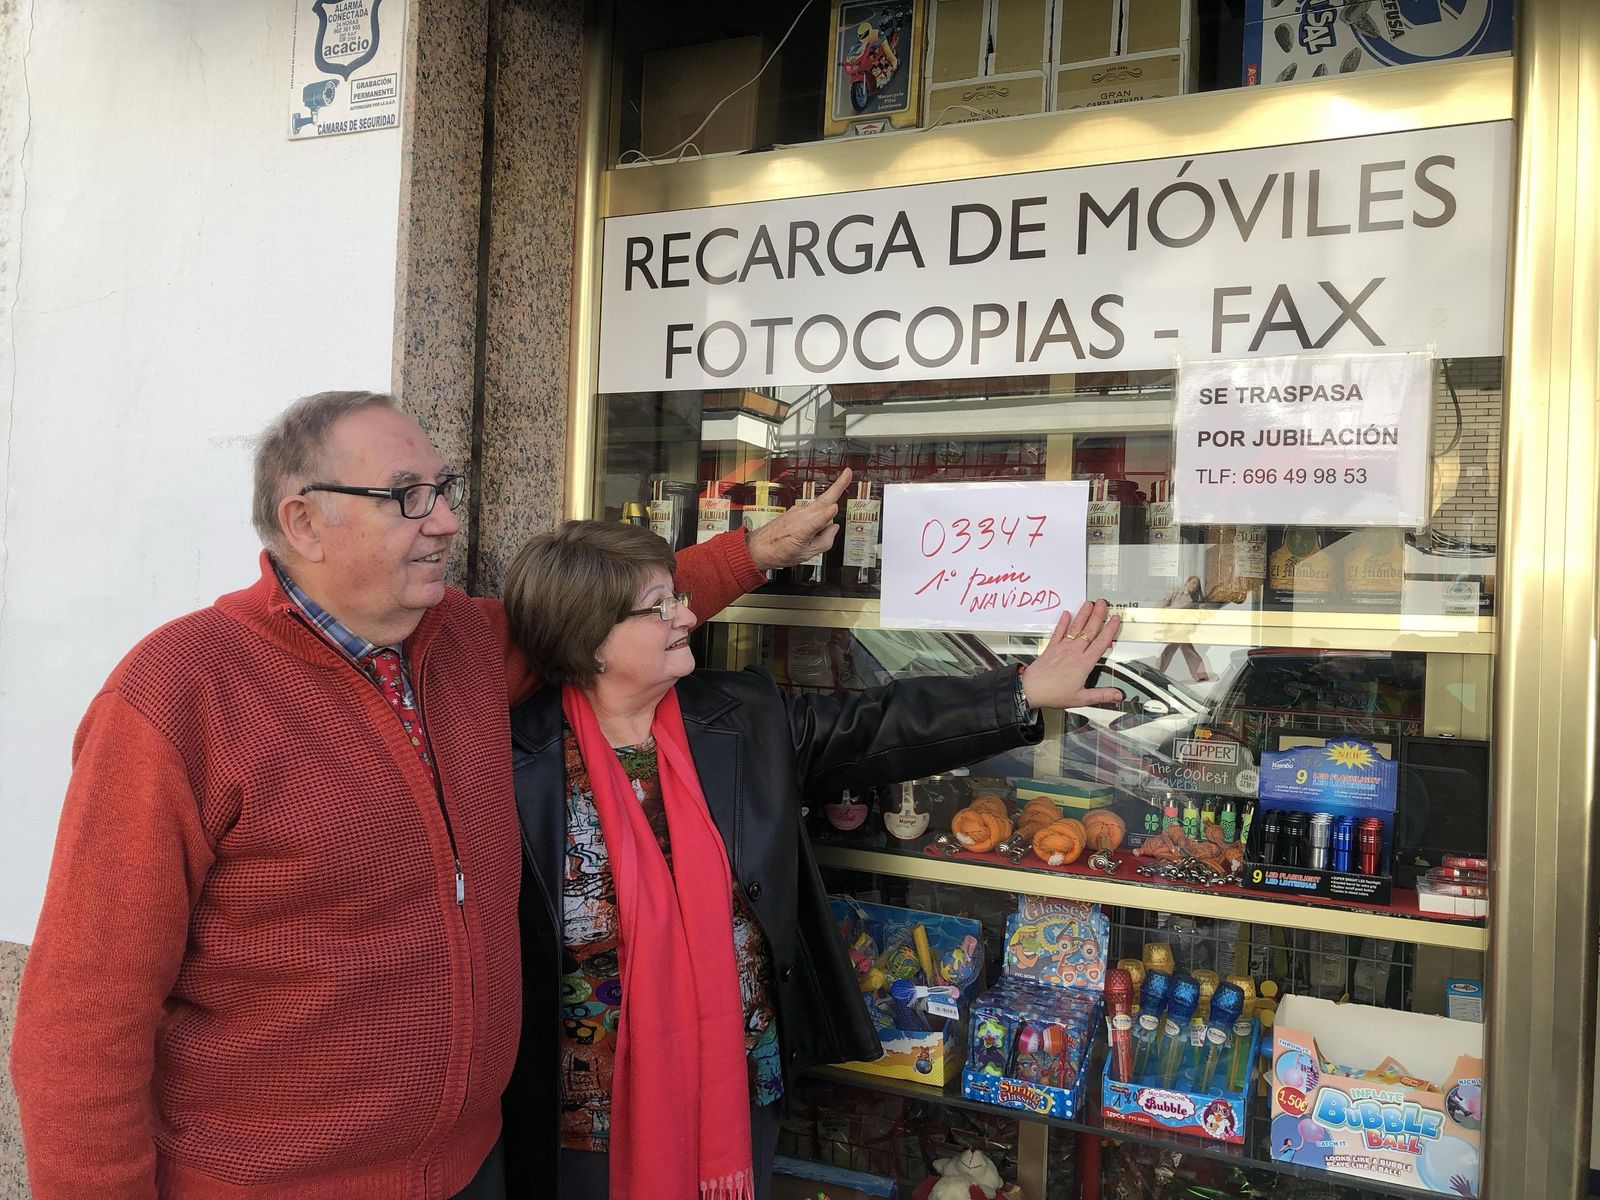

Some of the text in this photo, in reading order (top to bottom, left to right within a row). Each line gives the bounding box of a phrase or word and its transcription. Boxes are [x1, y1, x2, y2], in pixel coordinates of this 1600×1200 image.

[335, 1, 363, 12] ALARMA
[328, 8, 368, 23] CONECTADA
[1380, 0, 1406, 40] FUSA
[1303, 0, 1333, 52] SAL
[324, 36, 369, 56] acacio
[356, 78, 392, 89] GRABACIÓN
[353, 88, 394, 100] PERMANENTE
[1100, 90, 1131, 100] GRAN
[318, 114, 395, 135] CÁMARAS DE SEGURIDAD
[625, 160, 1456, 291] RECARGA DE MÓVILES
[665, 294, 1125, 379] FOTOCOPIAS
[1212, 277, 1386, 353] FAX
[1199, 384, 1363, 404] SE TRASPASA
[1198, 424, 1398, 447] POR JUBILACIÓN
[1196, 468, 1367, 484] TLF: 696 49 98 53
[921, 515, 1047, 557] 03347
[1179, 743, 1231, 759] CLIPPER
[1338, 750, 1360, 760] NEW
[1149, 763, 1228, 785] The coolest
[1296, 769, 1308, 784] 9
[1153, 776, 1198, 790] covers
[1252, 869, 1262, 883] 9
[1280, 872, 1322, 884] FLASHLIGHT
[1280, 879, 1316, 890] LINTERNAS
[1025, 902, 1088, 921] Glasses
[1280, 1040, 1300, 1051] THROW
[998, 1092, 1038, 1109] Glasses
[1000, 1081, 1042, 1104] Spring
[1148, 1091, 1186, 1101] MICROPHONE
[1351, 1088, 1403, 1103] INFLATE
[1144, 1096, 1188, 1116] Bubble
[1279, 1090, 1308, 1112] 1,50€
[1316, 1090, 1438, 1137] BUBBLE
[1316, 1140, 1340, 1148] CATCH
[1366, 1130, 1422, 1154] BALL
[1378, 1167, 1402, 1176] BALL!
[1381, 1160, 1412, 1172] BUBBLE
